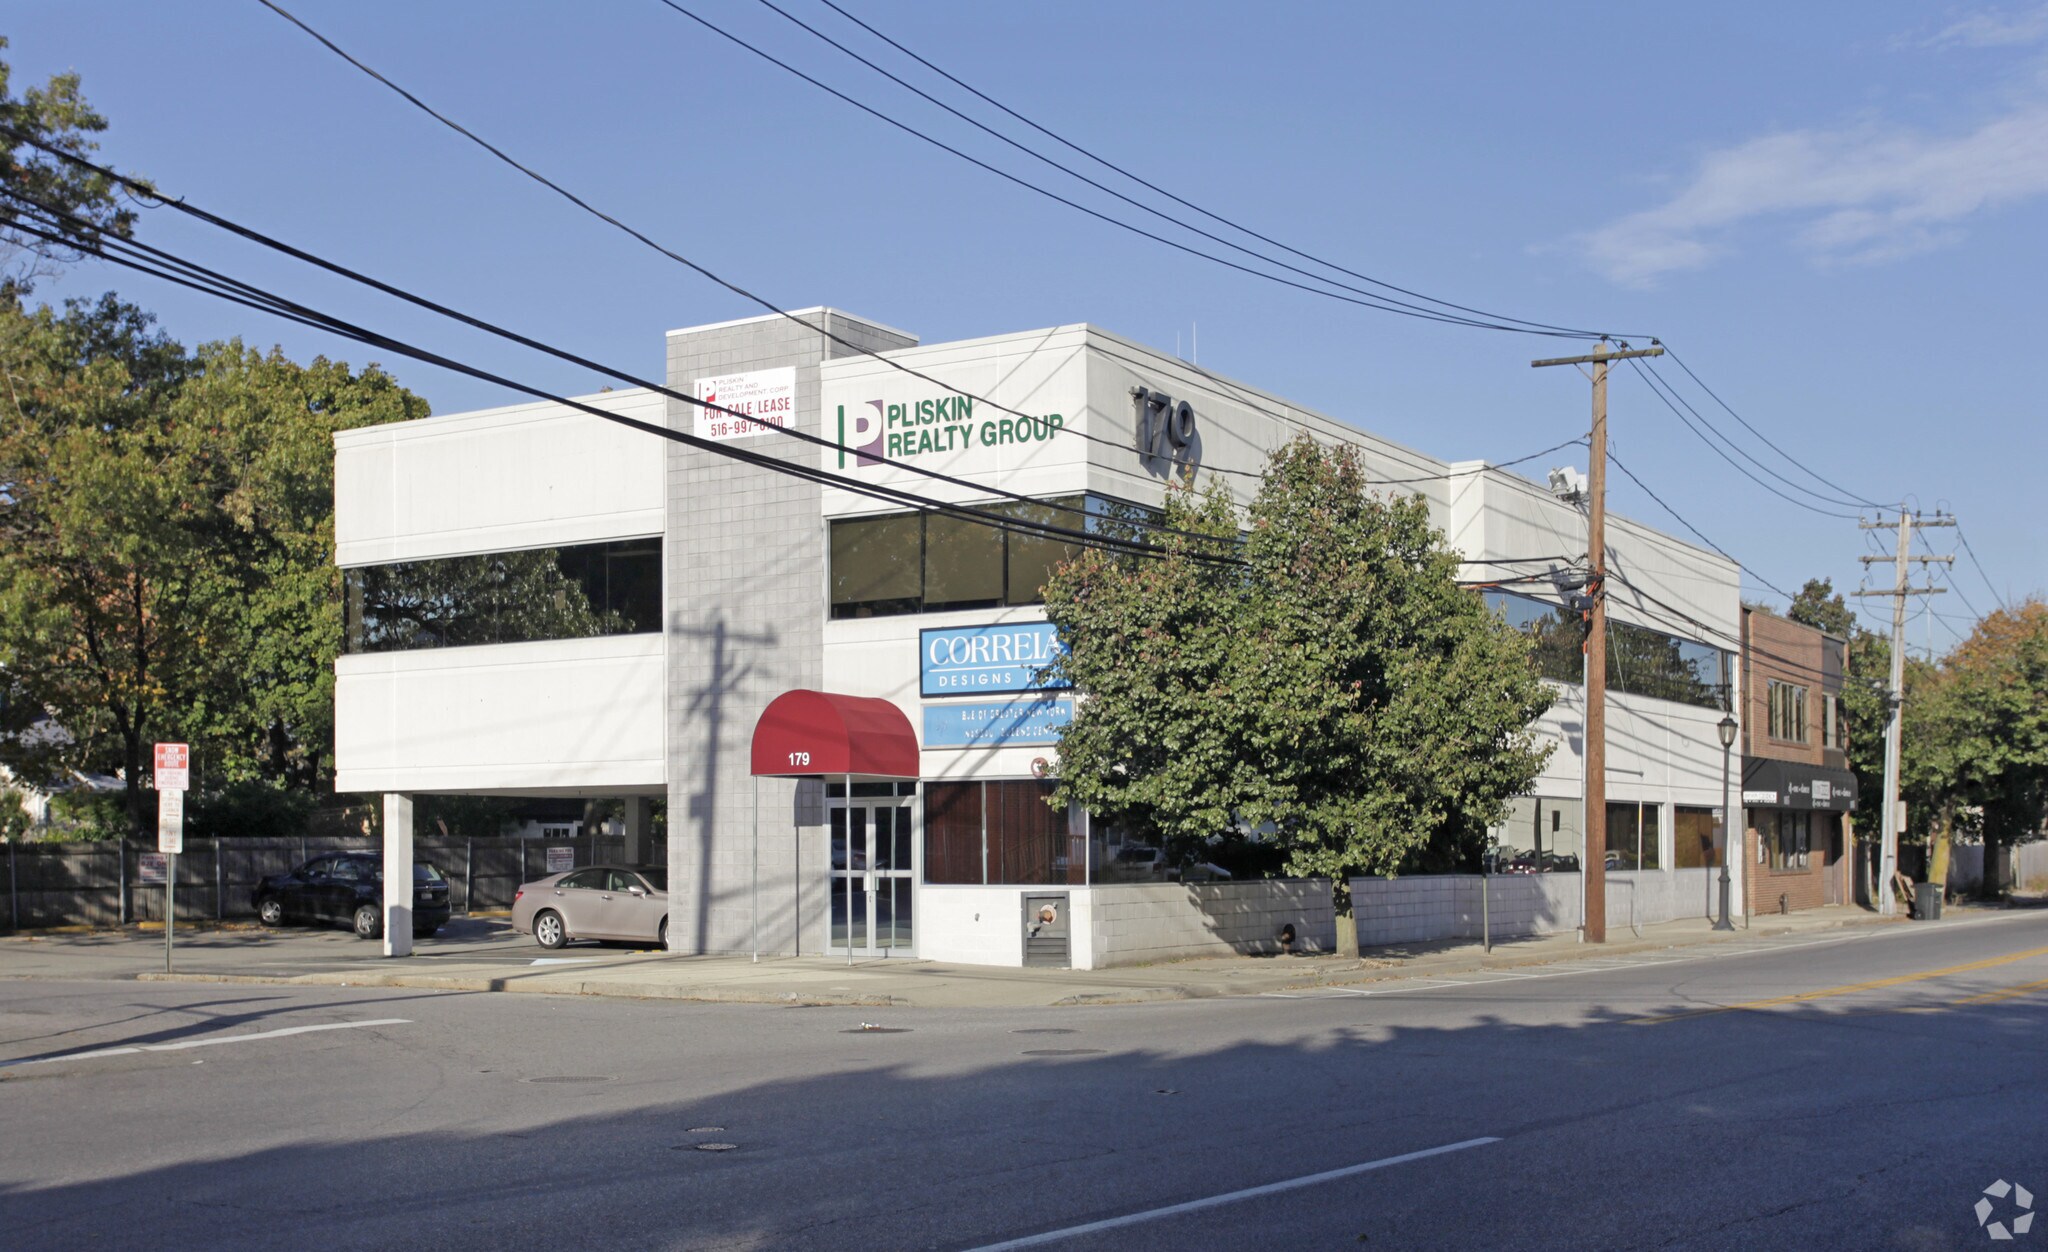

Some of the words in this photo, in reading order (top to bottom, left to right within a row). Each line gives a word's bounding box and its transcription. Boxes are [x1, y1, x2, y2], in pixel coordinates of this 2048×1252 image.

[719, 377, 744, 385] PLISKIN
[719, 385, 742, 393] REALTY
[704, 406, 722, 420] FOR
[888, 396, 973, 429] PLISKIN
[888, 424, 973, 457] REALTY
[980, 414, 1064, 447] GROUP
[929, 632, 1060, 665] CORREIA
[939, 673, 1011, 686] DESIGNS
[789, 752, 810, 766] 179
